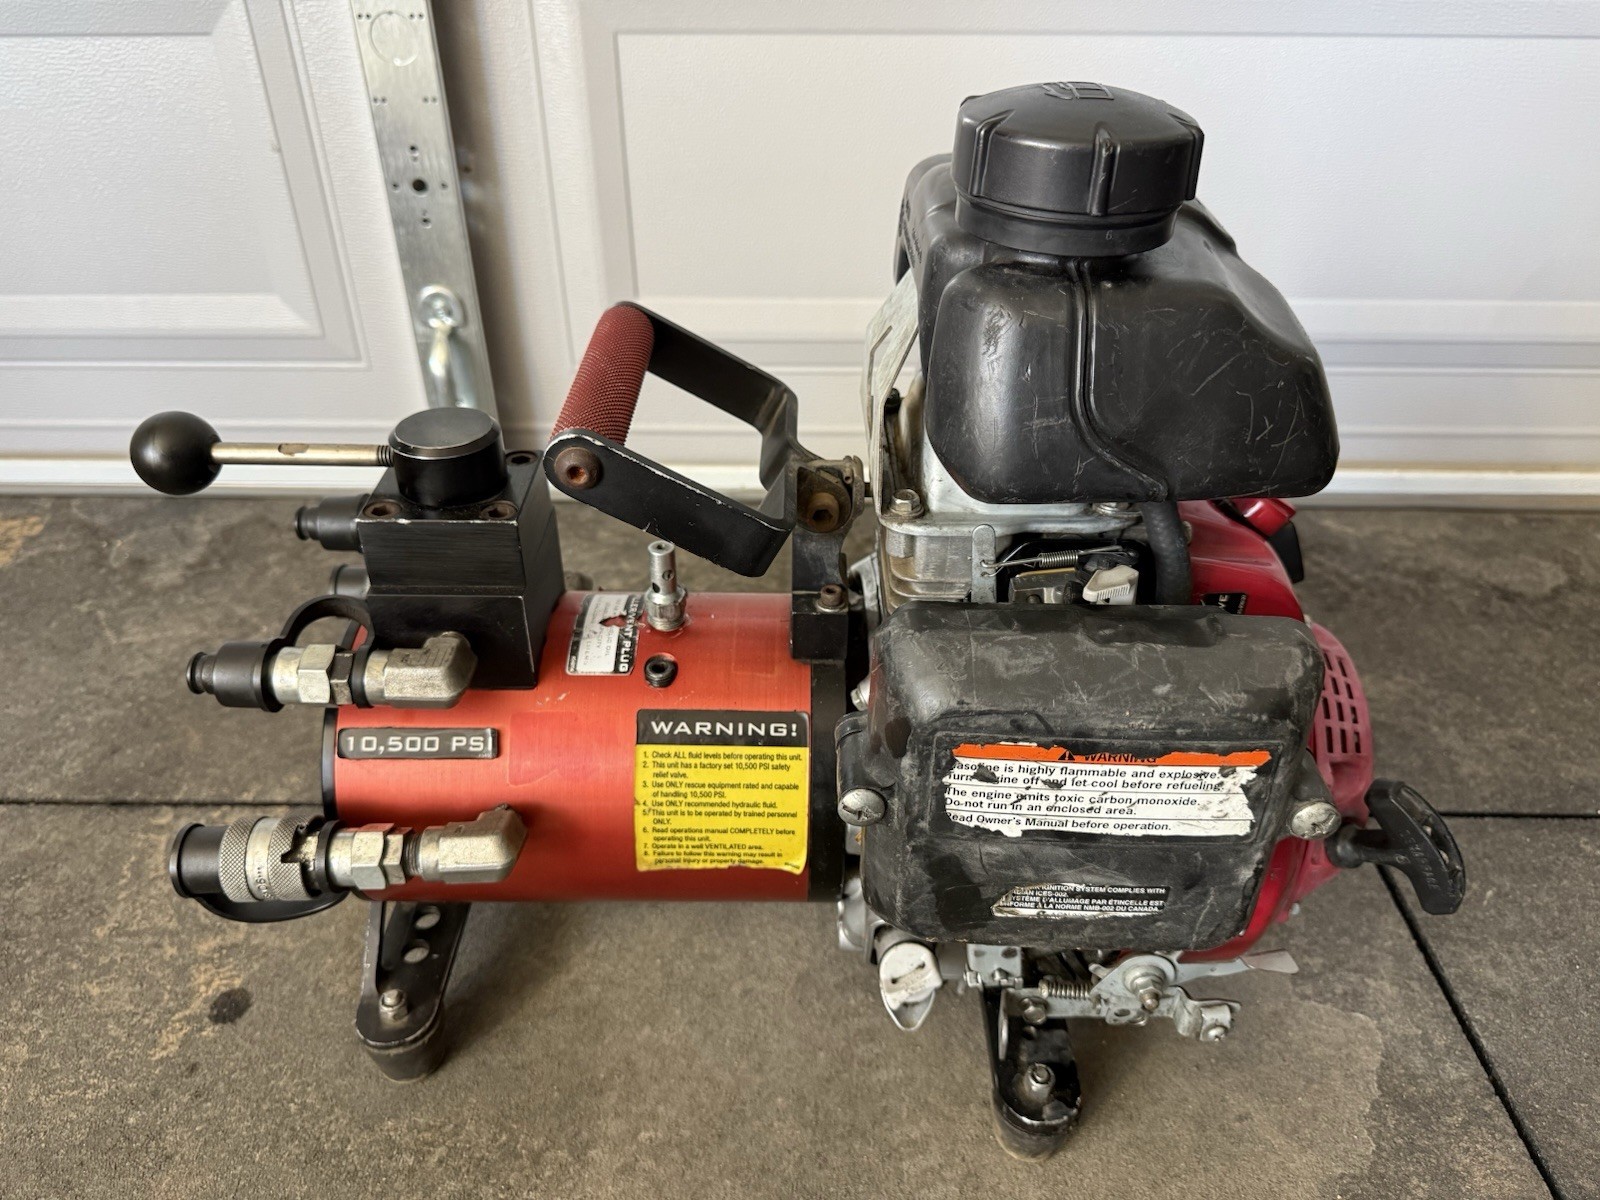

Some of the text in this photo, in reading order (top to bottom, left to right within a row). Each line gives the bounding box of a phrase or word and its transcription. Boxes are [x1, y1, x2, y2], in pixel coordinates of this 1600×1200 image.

[619, 640, 632, 672] PLUG
[651, 720, 798, 736] WARNING!
[346, 736, 492, 754] 10,500 PSI
[652, 750, 671, 758] Check
[723, 752, 743, 760] before
[1084, 752, 1157, 763] WARNI
[700, 762, 722, 770] factory
[736, 762, 757, 770] 10,500
[771, 764, 790, 772] safety
[1004, 763, 1014, 773] is
[1018, 764, 1055, 776] highly
[1060, 766, 1126, 778] flammable
[1132, 769, 1154, 778] and
[1160, 770, 1220, 780] explosive.
[708, 782, 741, 790] equipment
[1023, 777, 1040, 785] off
[1071, 778, 1087, 787] let
[1091, 779, 1118, 788] cool
[1122, 780, 1162, 789] before
[1167, 781, 1224, 792] refueling.
[660, 791, 688, 799] handling
[946, 787, 1200, 806] The engine emits toxic carbon monoxide.
[685, 800, 730, 808] recommended
[732, 801, 761, 809] hydraulic
[946, 797, 960, 806] Do
[964, 800, 983, 808] not
[988, 802, 1007, 810] run
[1012, 802, 1022, 811] in
[1046, 804, 1100, 814] enclosed
[1105, 808, 1137, 816] area.
[976, 815, 1021, 826] Owner's
[1025, 818, 1068, 828] Manual
[1072, 820, 1109, 829] before
[1113, 822, 1171, 830] operation.
